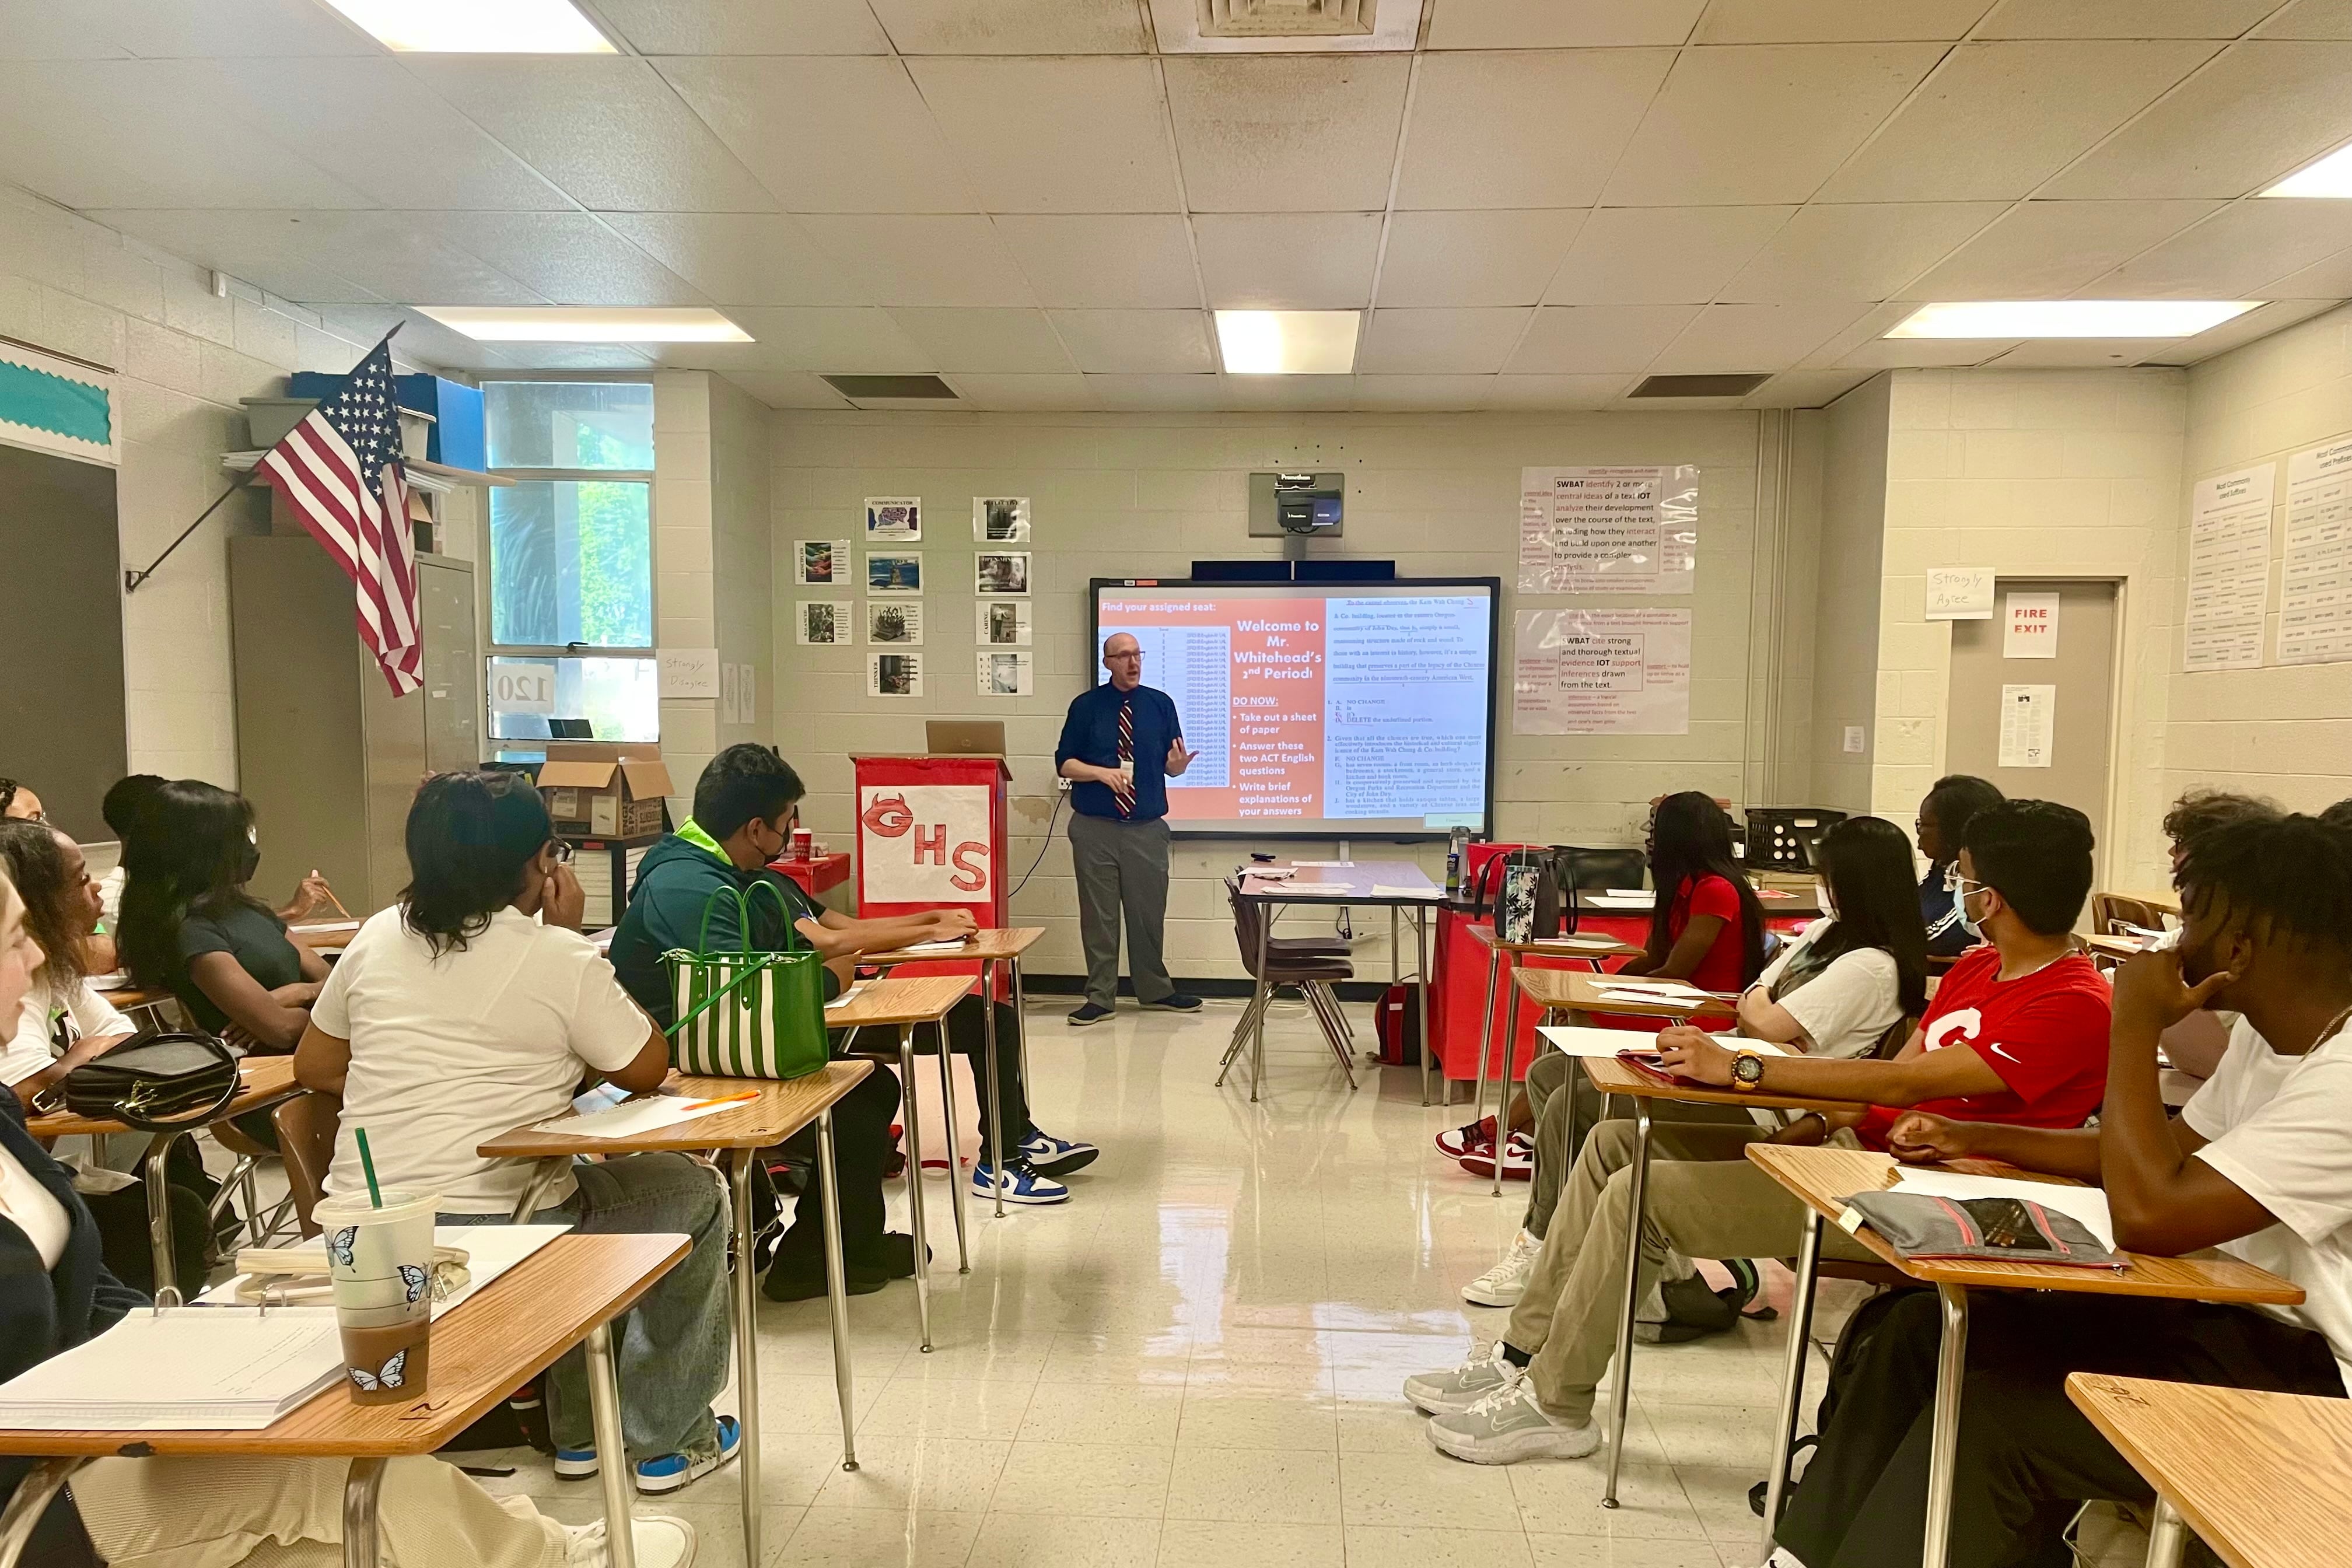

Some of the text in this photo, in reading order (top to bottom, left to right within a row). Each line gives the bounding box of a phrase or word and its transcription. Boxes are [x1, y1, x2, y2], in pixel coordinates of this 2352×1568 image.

[1586, 481, 1614, 489] identify
[1933, 573, 1982, 588] Strongly
[1936, 593, 1970, 607] Agree
[1102, 603, 1122, 611] Find
[1125, 604, 1147, 612] your
[1149, 603, 1190, 612] assigned
[2015, 609, 2048, 618] FIRE
[1237, 620, 1320, 631] Welcome to
[2014, 625, 2048, 634] EXIT
[1266, 635, 1289, 647] Mr.
[1234, 650, 1322, 663] Whitehead's
[1242, 666, 1260, 679] 2nd
[670, 676, 709, 688] Disagree
[1233, 696, 1279, 705] DO NOW:
[1240, 713, 1261, 722] Take
[1290, 712, 1317, 721] sheet
[1240, 725, 1280, 735] of paper
[1240, 741, 1303, 750] Answer these
[1261, 754, 1279, 762] ACT
[1282, 753, 1314, 764] English
[1240, 766, 1285, 776] questions
[1240, 782, 1291, 791] Write brief
[1239, 794, 1312, 805] explanations of
[1239, 808, 1261, 817] your
